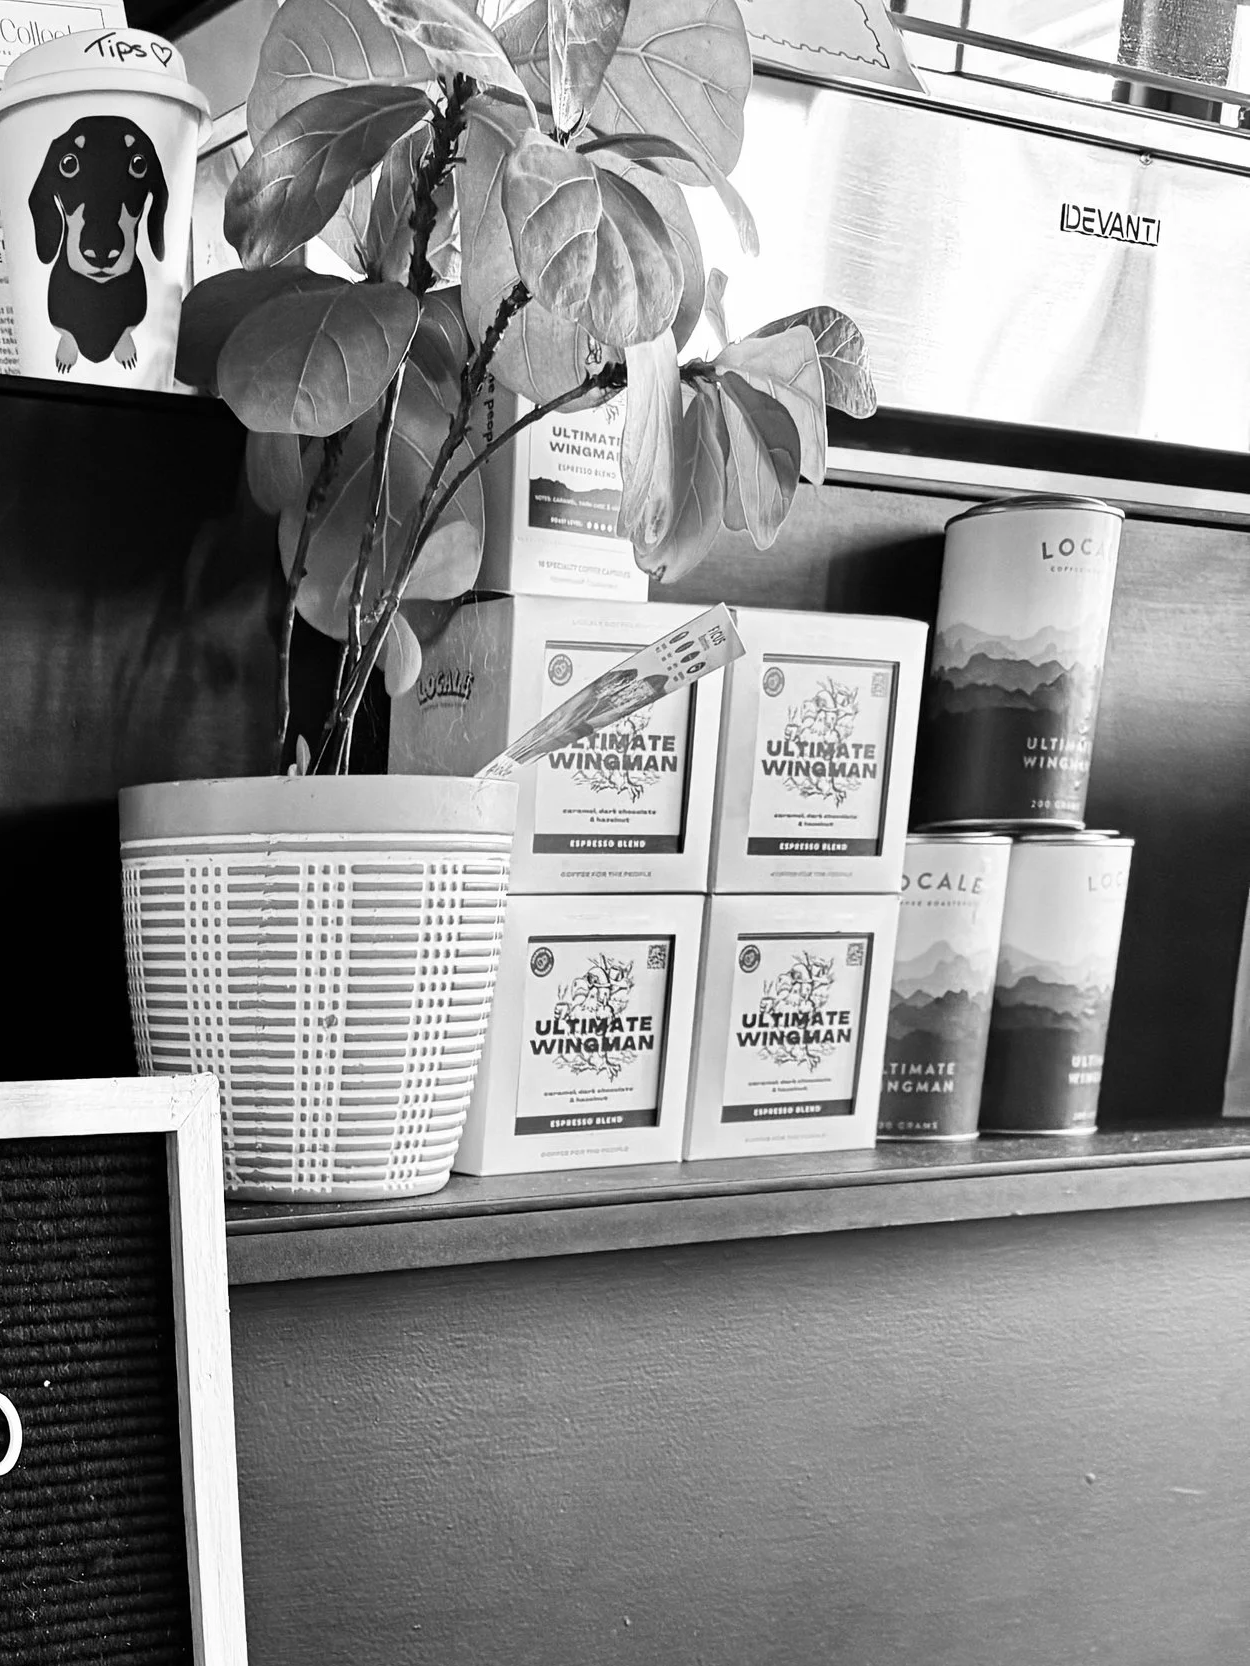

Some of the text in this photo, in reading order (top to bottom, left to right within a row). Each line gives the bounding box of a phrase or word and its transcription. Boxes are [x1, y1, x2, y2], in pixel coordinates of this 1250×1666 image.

[0, 18, 71, 46] Colle
[84, 32, 148, 62] Tips
[1061, 203, 1161, 245] DEVANTI
[766, 740, 876, 760] ULTIMATE
[549, 753, 678, 772] WINGMAN
[761, 760, 877, 779] WINGMAN
[570, 839, 646, 848] ESPRESSO BLEND
[779, 842, 848, 851] ESPRESSO BLEND
[535, 1016, 653, 1036] ULTIMATE
[742, 1011, 850, 1029] ULTIMATE
[530, 1035, 655, 1055] WINGMAN
[736, 1028, 851, 1047] WINGMAN
[753, 1105, 821, 1117] ESPRESSO BLEND
[550, 1116, 623, 1128] ESPRESSO BLEND
